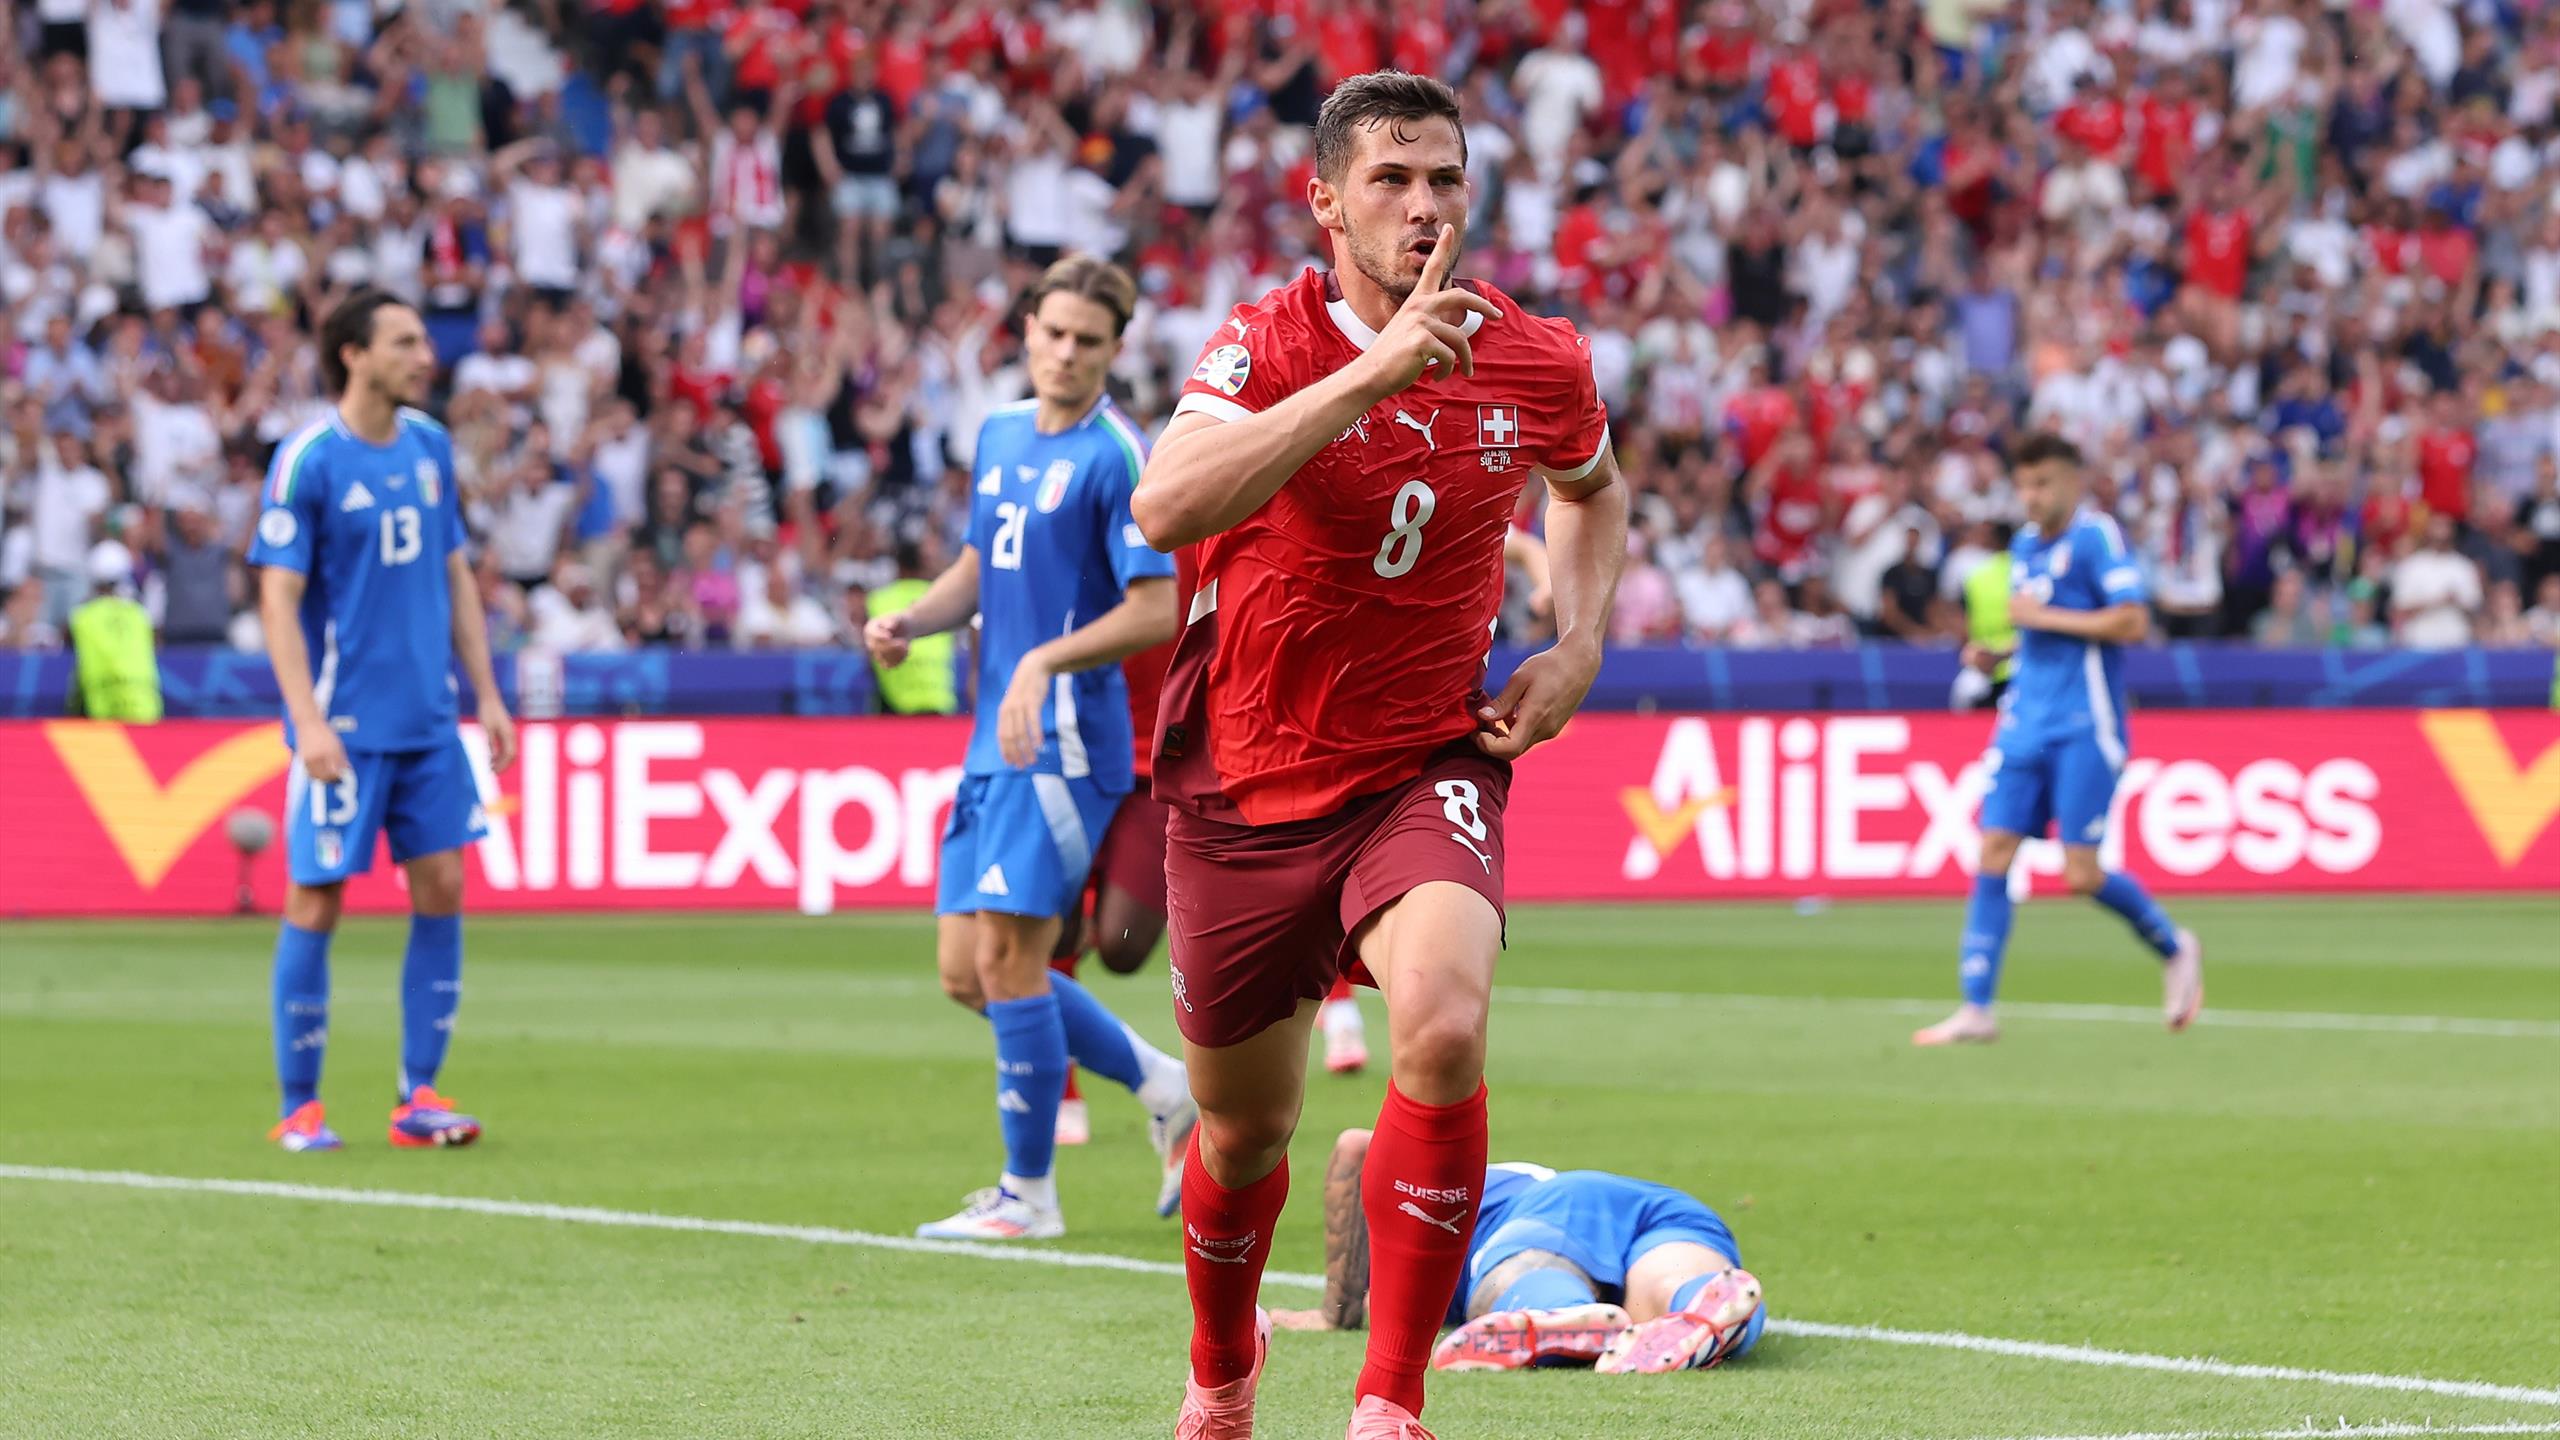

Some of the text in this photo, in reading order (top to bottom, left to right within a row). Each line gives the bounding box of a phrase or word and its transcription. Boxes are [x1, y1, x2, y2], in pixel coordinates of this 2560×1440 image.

[1480, 456, 1492, 466] SUI
[1499, 456, 1511, 465] ITA
[380, 505, 423, 567] 13
[991, 501, 1029, 571] 21
[1373, 480, 1436, 579] 8
[309, 766, 360, 826] 13
[1434, 779, 1488, 842] 8
[1393, 1178, 1470, 1204] SUISSE
[1187, 1222, 1257, 1249] SUISSE
